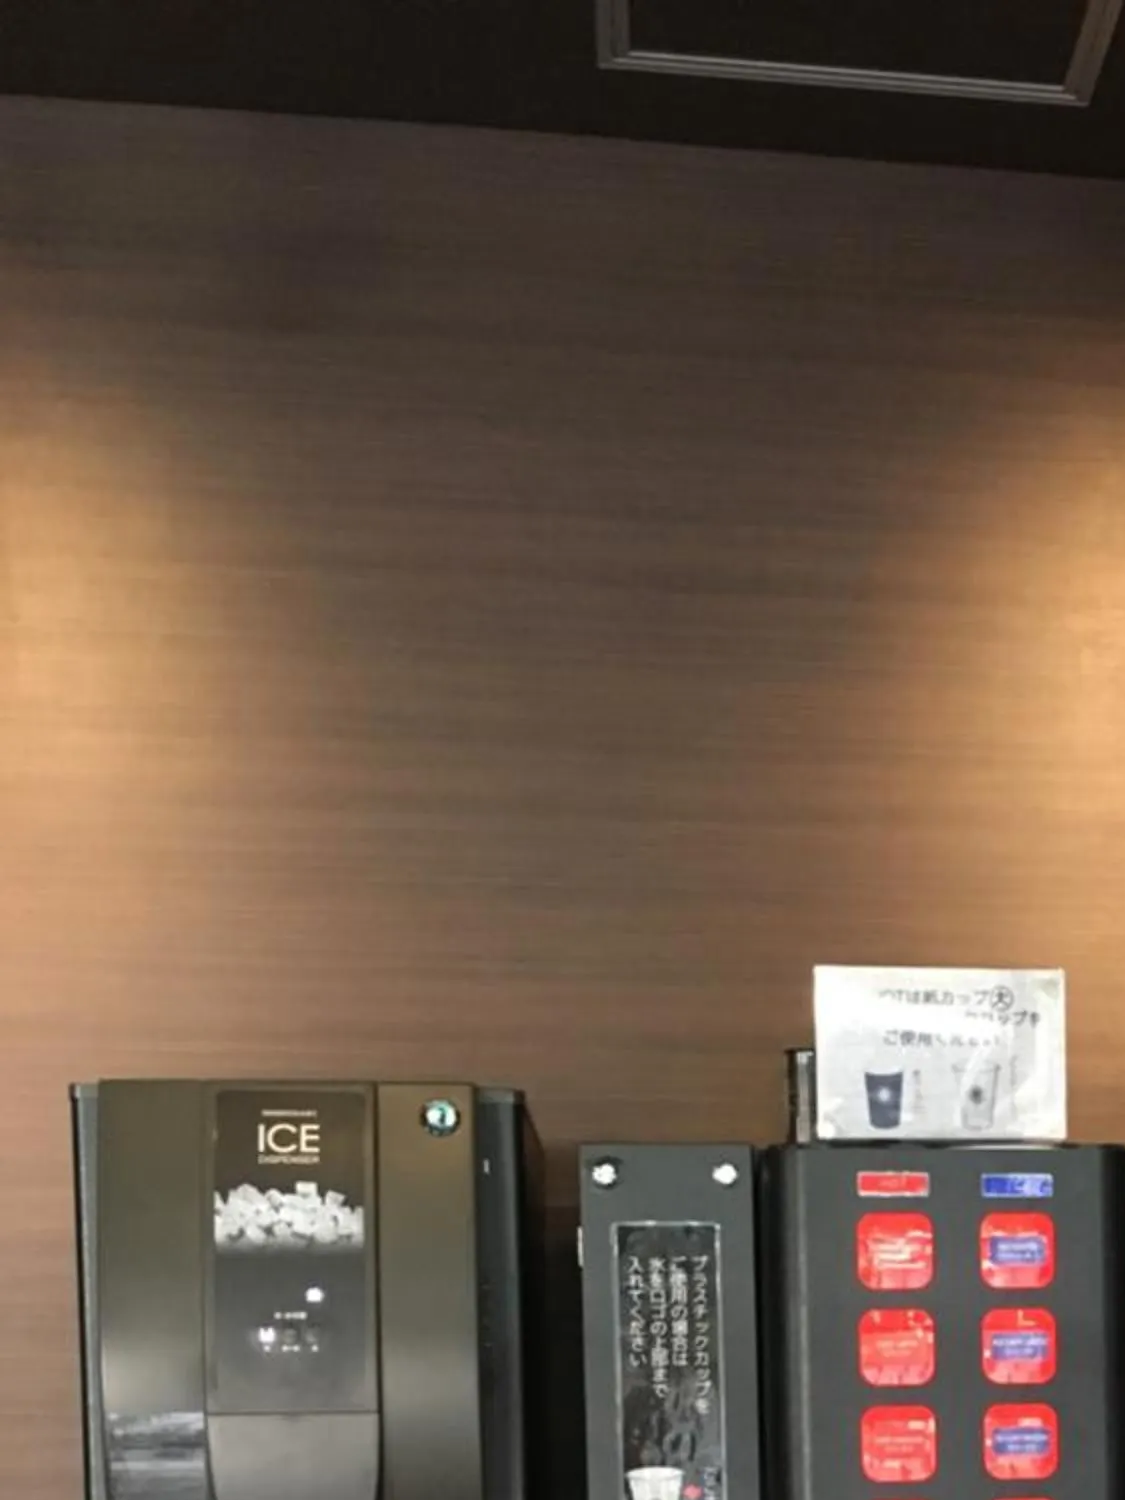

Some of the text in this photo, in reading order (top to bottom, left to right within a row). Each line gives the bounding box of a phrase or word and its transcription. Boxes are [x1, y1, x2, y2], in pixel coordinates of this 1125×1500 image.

[258, 1123, 320, 1153] ICE
[628, 1255, 648, 1368] 入れてください
